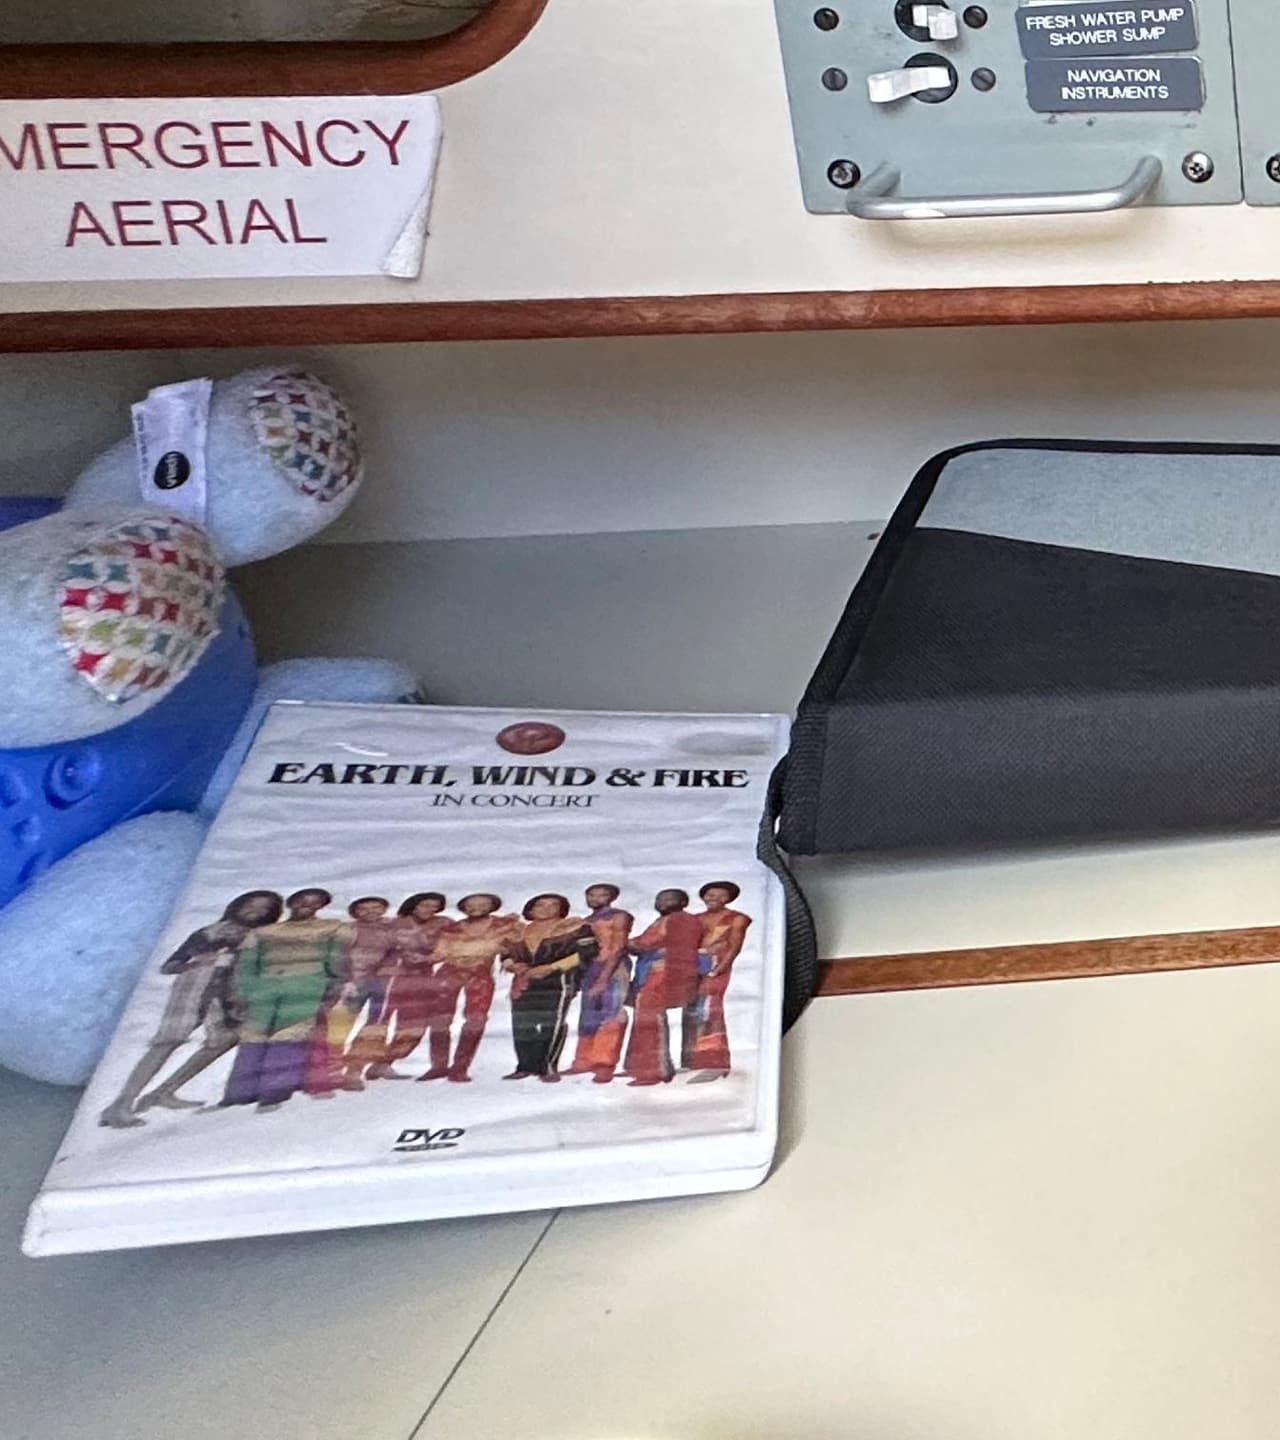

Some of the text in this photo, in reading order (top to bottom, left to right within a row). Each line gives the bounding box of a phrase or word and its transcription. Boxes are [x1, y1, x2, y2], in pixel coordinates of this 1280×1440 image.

[1025, 7, 1184, 31] FRESH WATER PUMP
[1050, 27, 1166, 46] SHOWER SUMP
[1067, 68, 1161, 82] NAVIGATION
[1062, 85, 1169, 100] INSTRUMENTS
[65, 197, 327, 248] AERIAL
[266, 762, 751, 788] EARTH, WIND & FIRE
[431, 793, 601, 808] IN CONCERT
[395, 1127, 466, 1144] DVD
